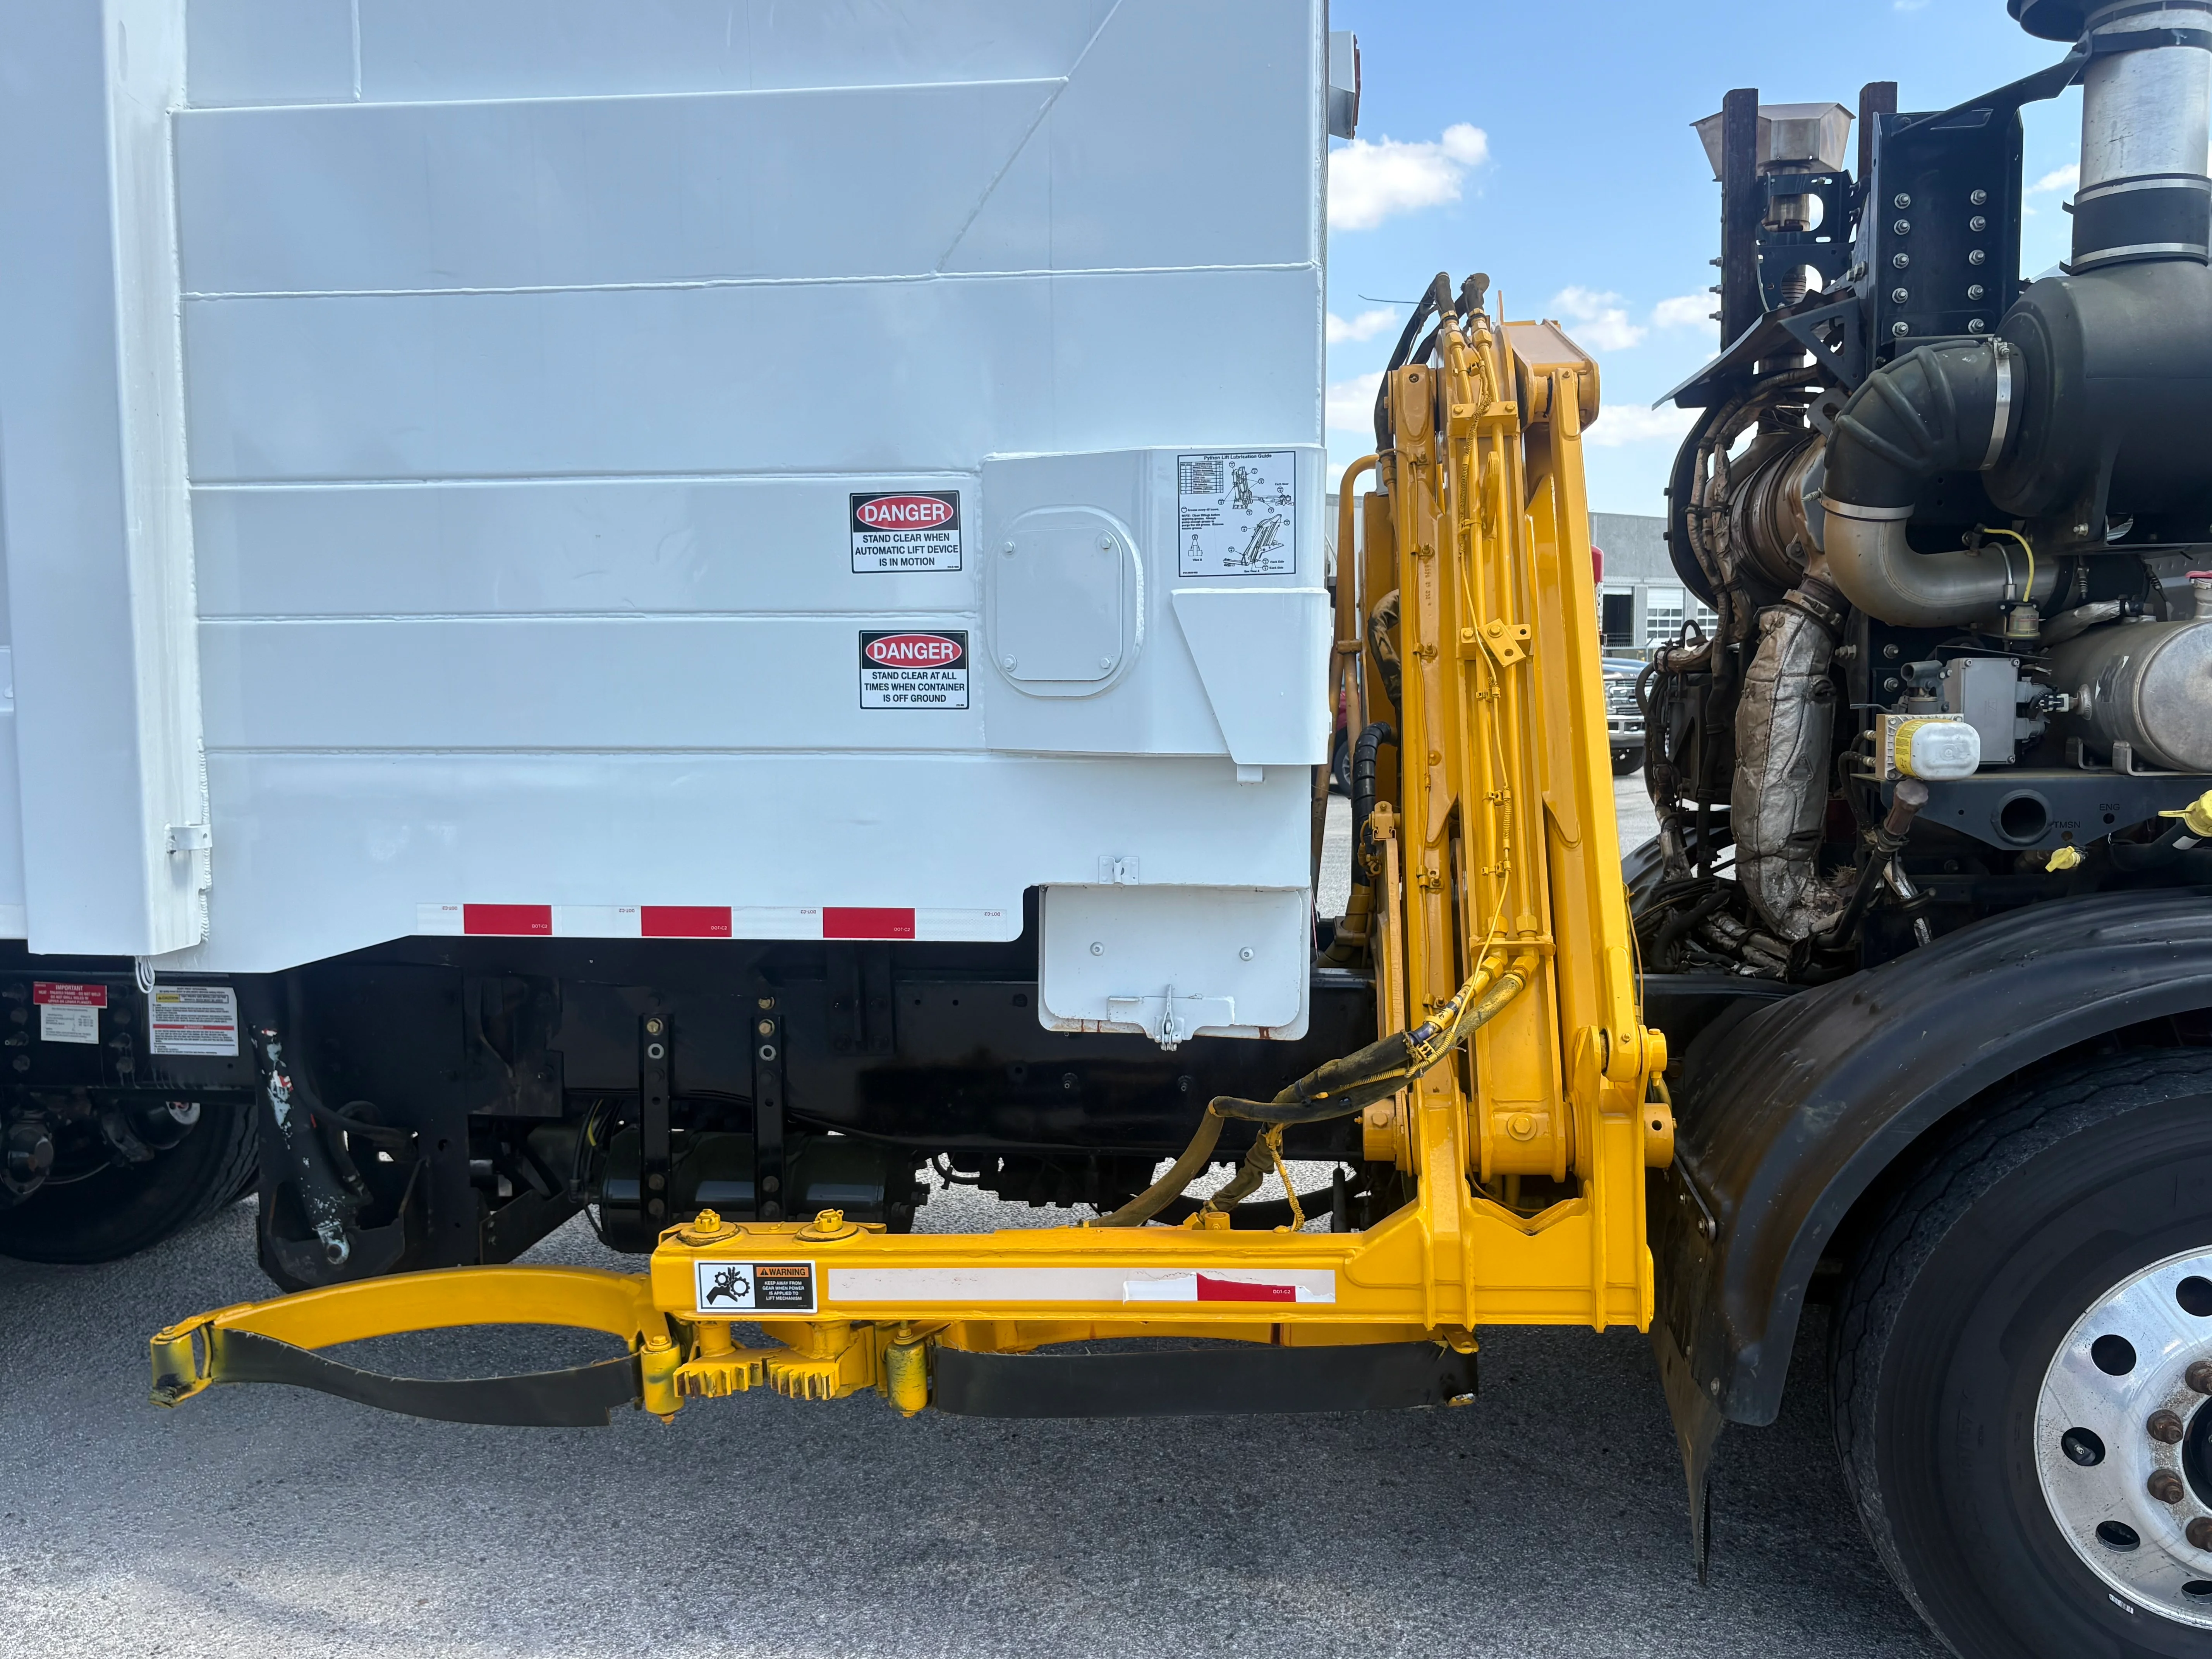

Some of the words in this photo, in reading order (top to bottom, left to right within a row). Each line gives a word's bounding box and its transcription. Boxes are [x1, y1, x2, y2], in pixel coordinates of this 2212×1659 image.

[865, 504, 945, 522] DANGER
[863, 534, 891, 543] STAND
[893, 534, 921, 542] CLEAR
[924, 533, 950, 541] WHEN
[855, 546, 905, 555] AUTOMATIC
[908, 546, 925, 554] LIFT
[927, 545, 958, 553] DEVICE
[890, 558, 898, 566] IN
[901, 557, 935, 566] MOTION
[874, 643, 953, 659] DANGER
